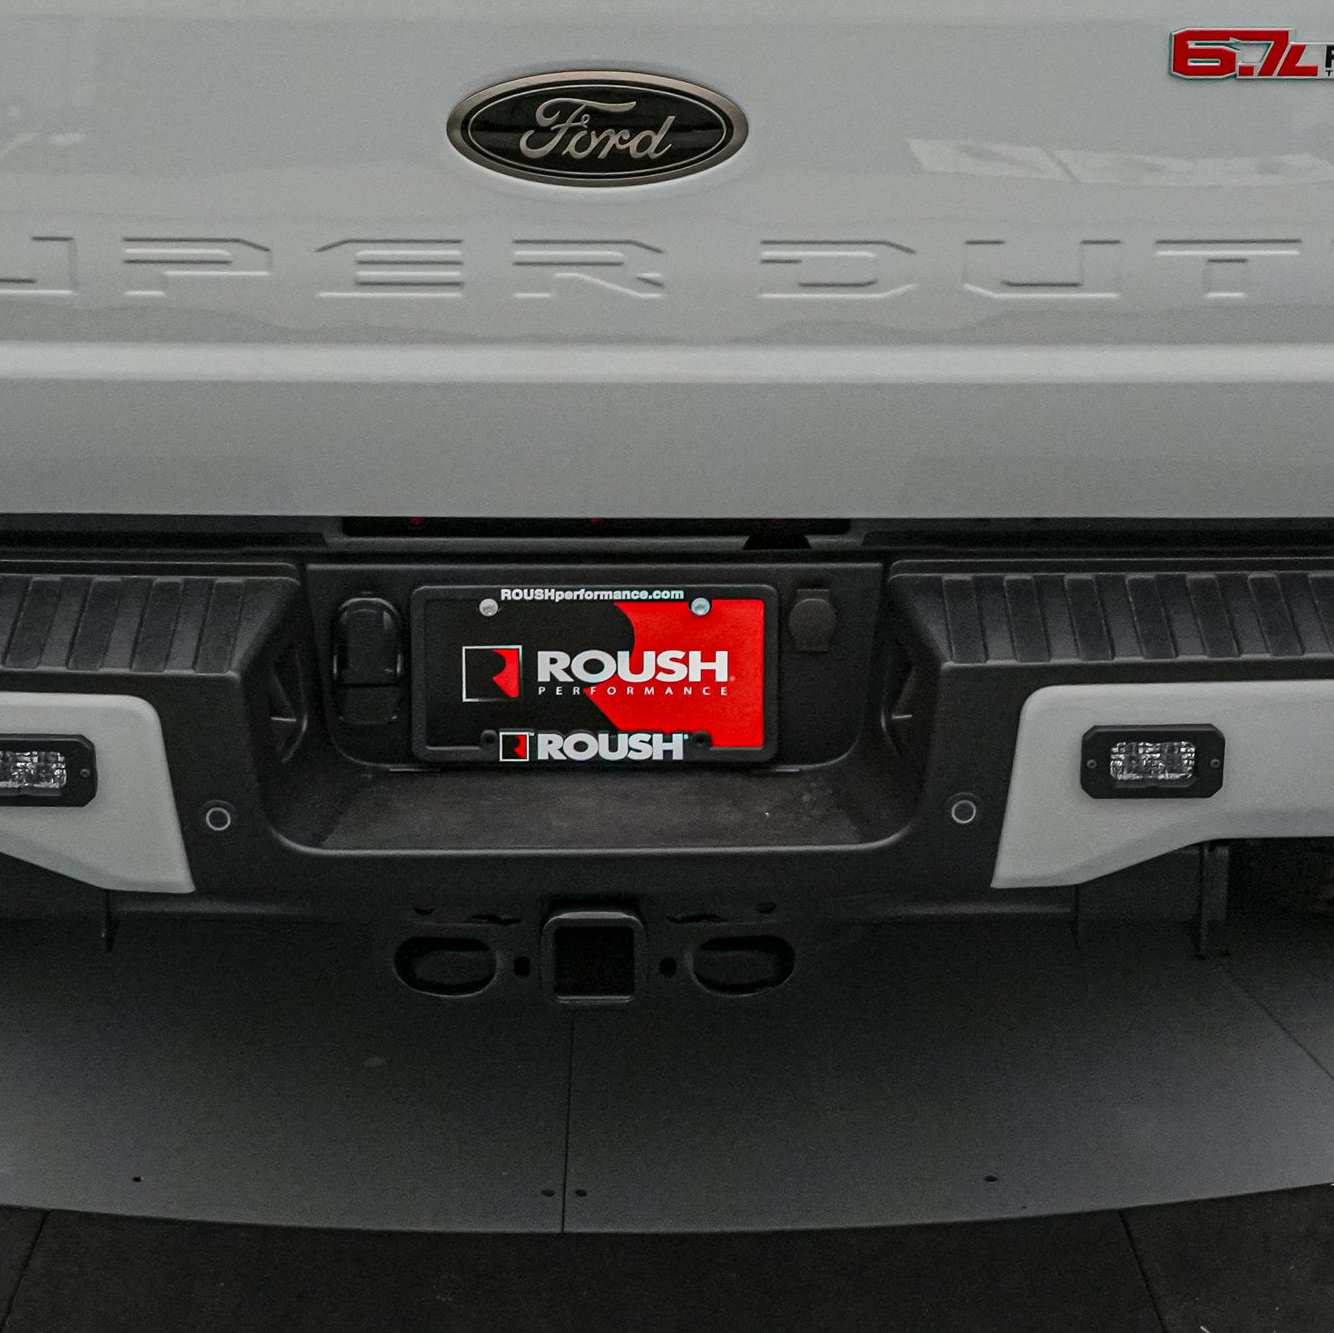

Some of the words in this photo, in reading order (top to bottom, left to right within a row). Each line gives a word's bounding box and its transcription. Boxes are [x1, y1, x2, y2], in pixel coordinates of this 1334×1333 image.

[1172, 29, 1319, 77] 6.7L
[519, 97, 676, 160] Ford
[500, 589, 685, 602] ROUSHperformance.com
[537, 650, 729, 683] ROUSH
[538, 686, 728, 696] PERFORMANCE
[537, 733, 684, 761] ROUSH
